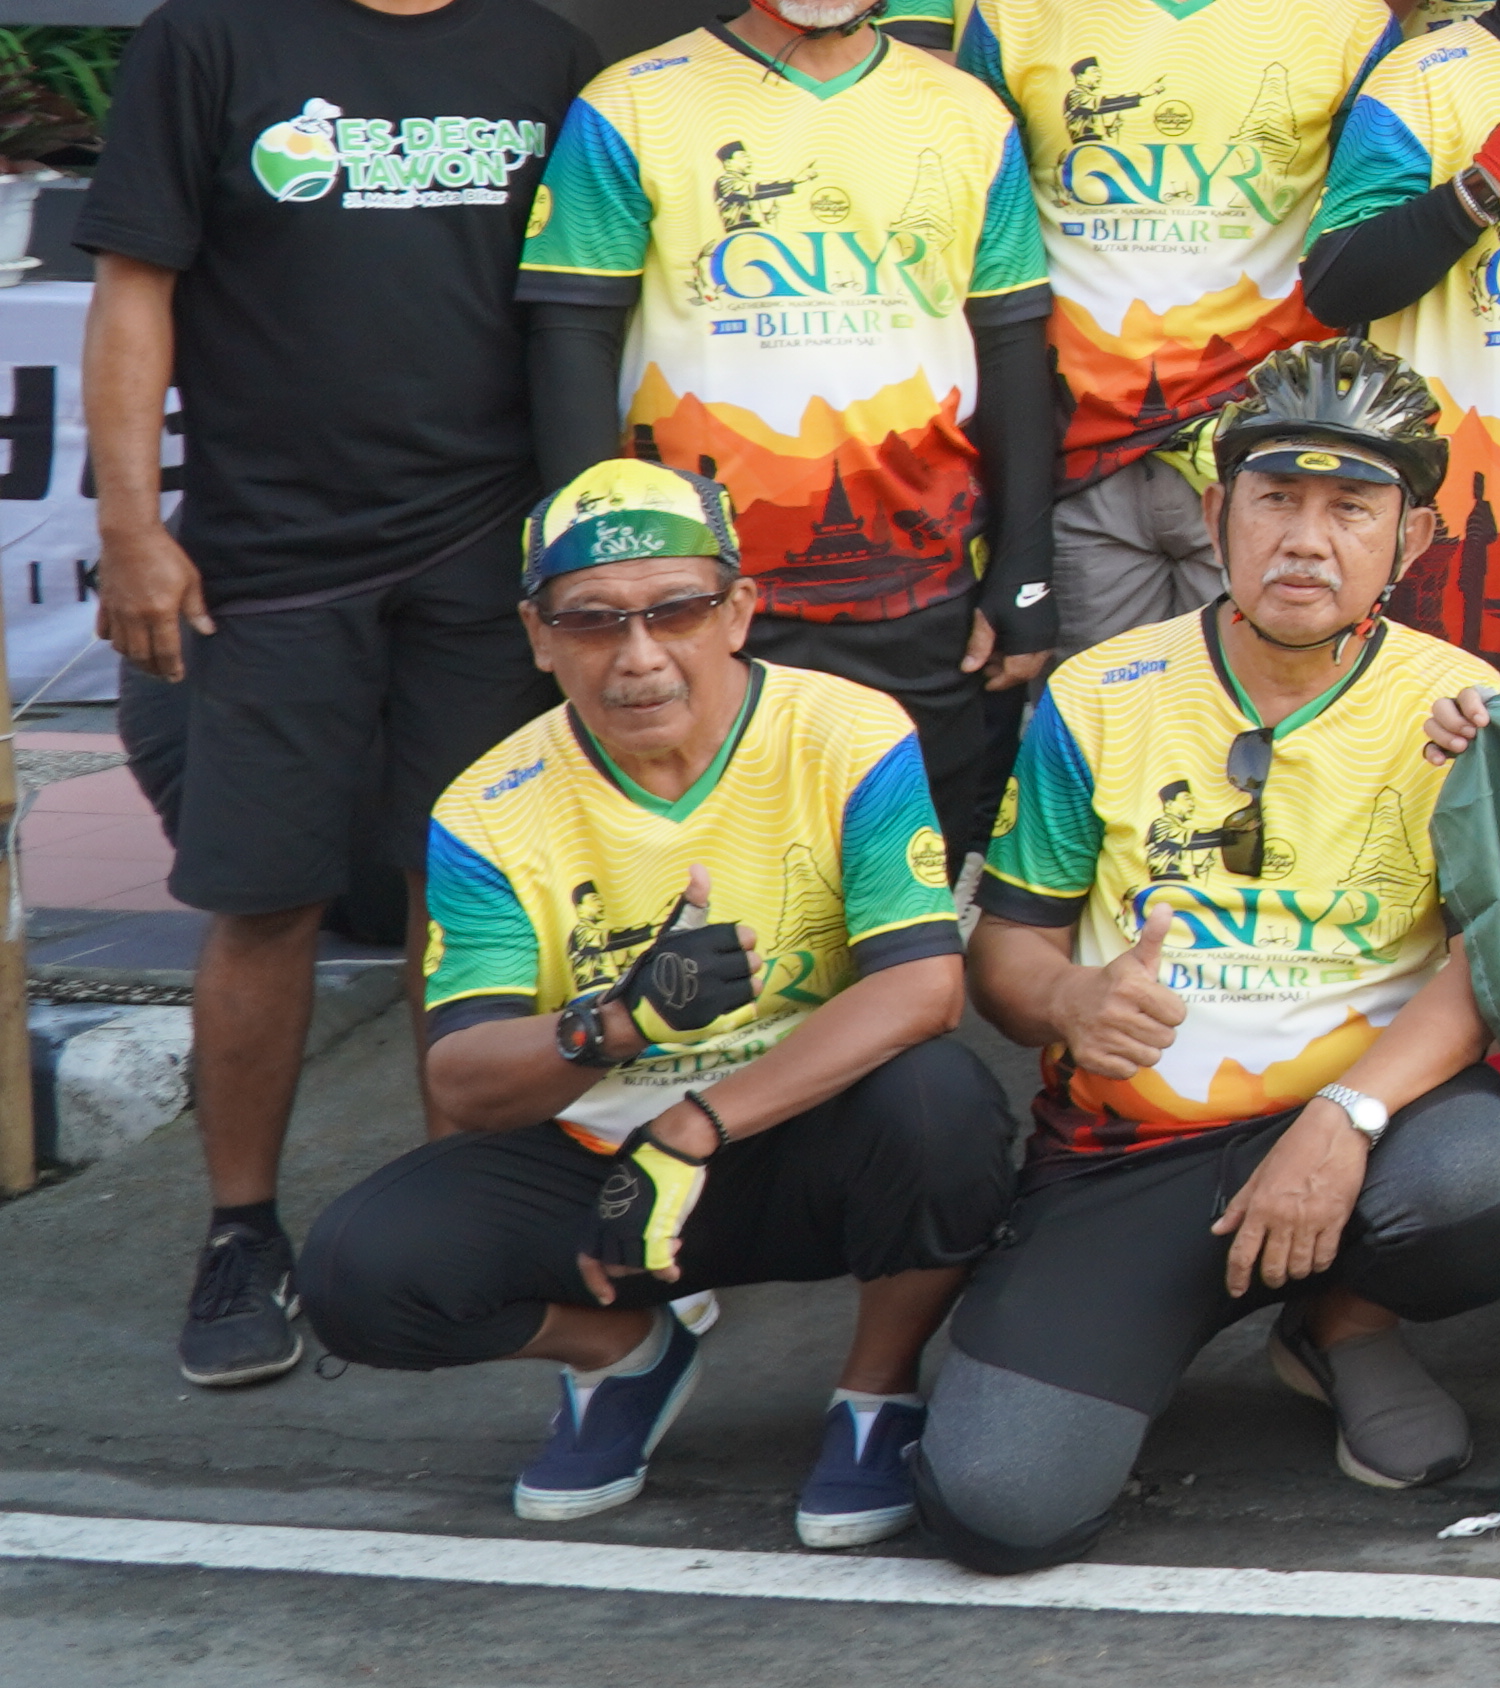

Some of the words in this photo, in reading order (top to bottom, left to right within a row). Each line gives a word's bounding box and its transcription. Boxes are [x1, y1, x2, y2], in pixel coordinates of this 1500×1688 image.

[337, 118, 394, 154] ES
[401, 117, 546, 158] DEGAN
[341, 152, 508, 191] TAWON
[1090, 217, 1211, 243] BLITAR
[755, 312, 882, 339] BLITAR
[1167, 962, 1311, 991] BLITAR
